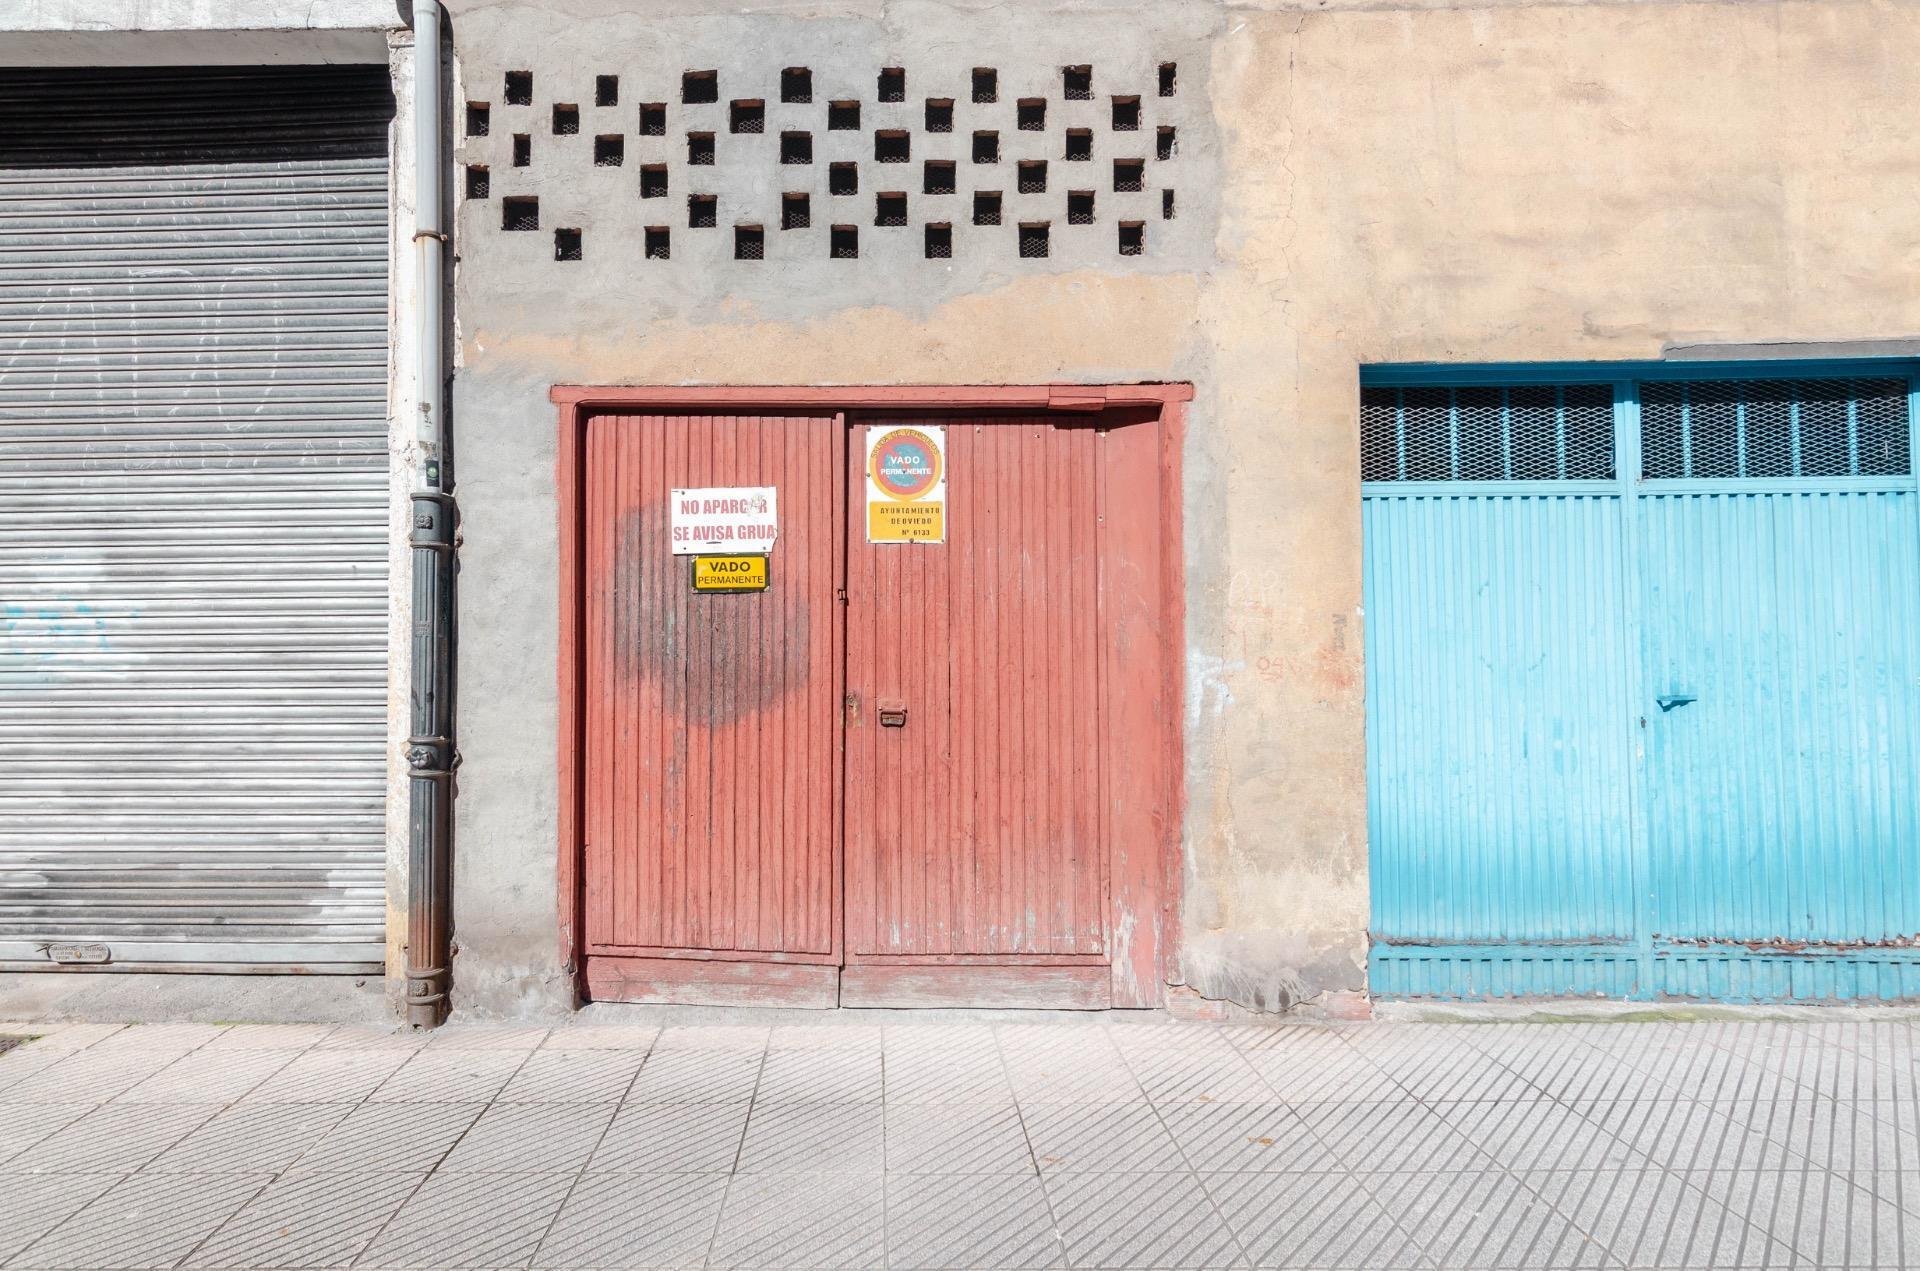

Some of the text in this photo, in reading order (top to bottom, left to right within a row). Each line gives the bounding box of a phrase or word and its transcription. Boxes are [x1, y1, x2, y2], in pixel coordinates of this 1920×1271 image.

[890, 429, 902, 437] DE
[890, 456, 920, 465] VADO
[681, 499, 768, 515] NO APARCR
[673, 524, 776, 541] SE AVISA GRUA
[709, 561, 751, 573] VADO
[698, 575, 764, 584] PERMANENTE
